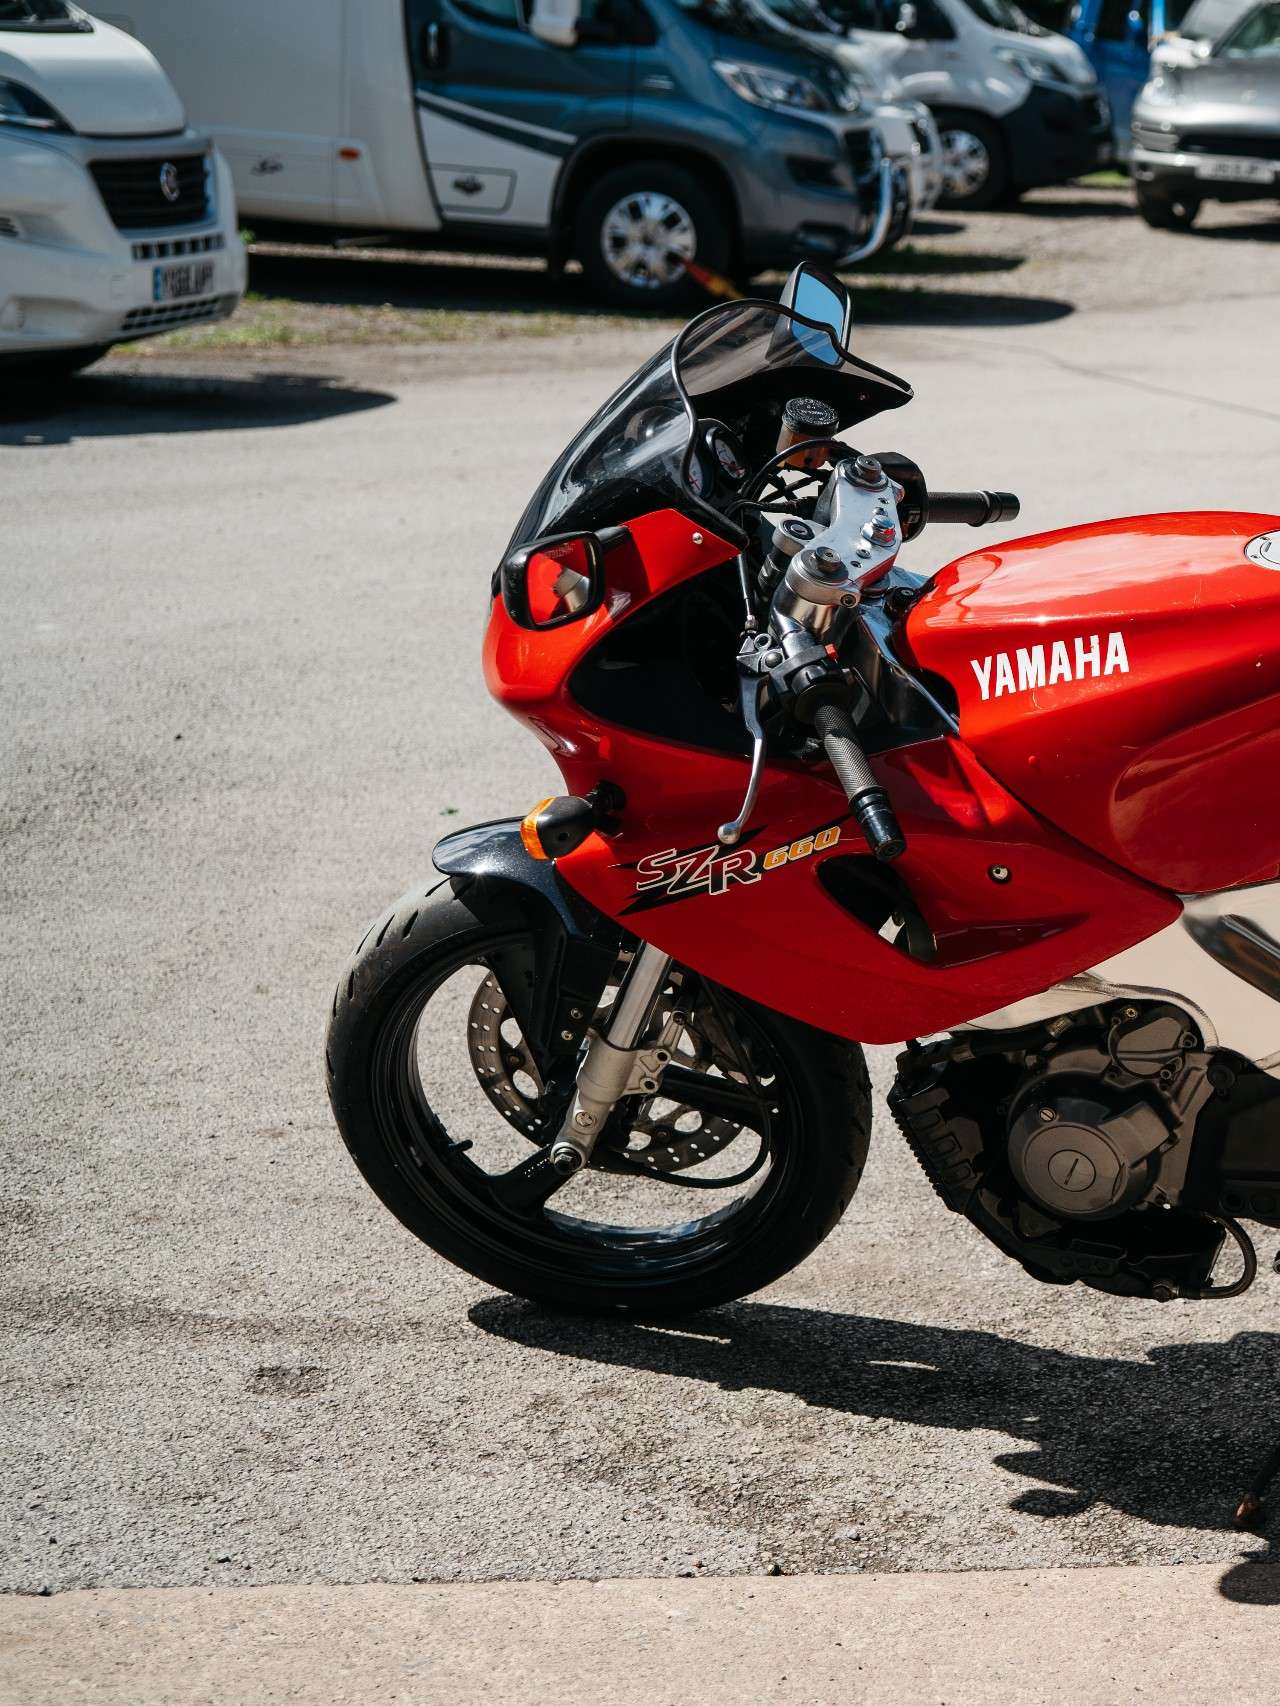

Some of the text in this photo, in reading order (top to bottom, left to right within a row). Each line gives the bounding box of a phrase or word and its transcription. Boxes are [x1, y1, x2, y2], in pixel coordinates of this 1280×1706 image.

[970, 632, 1130, 701] YAMAHA
[636, 826, 841, 895] SZR 660
